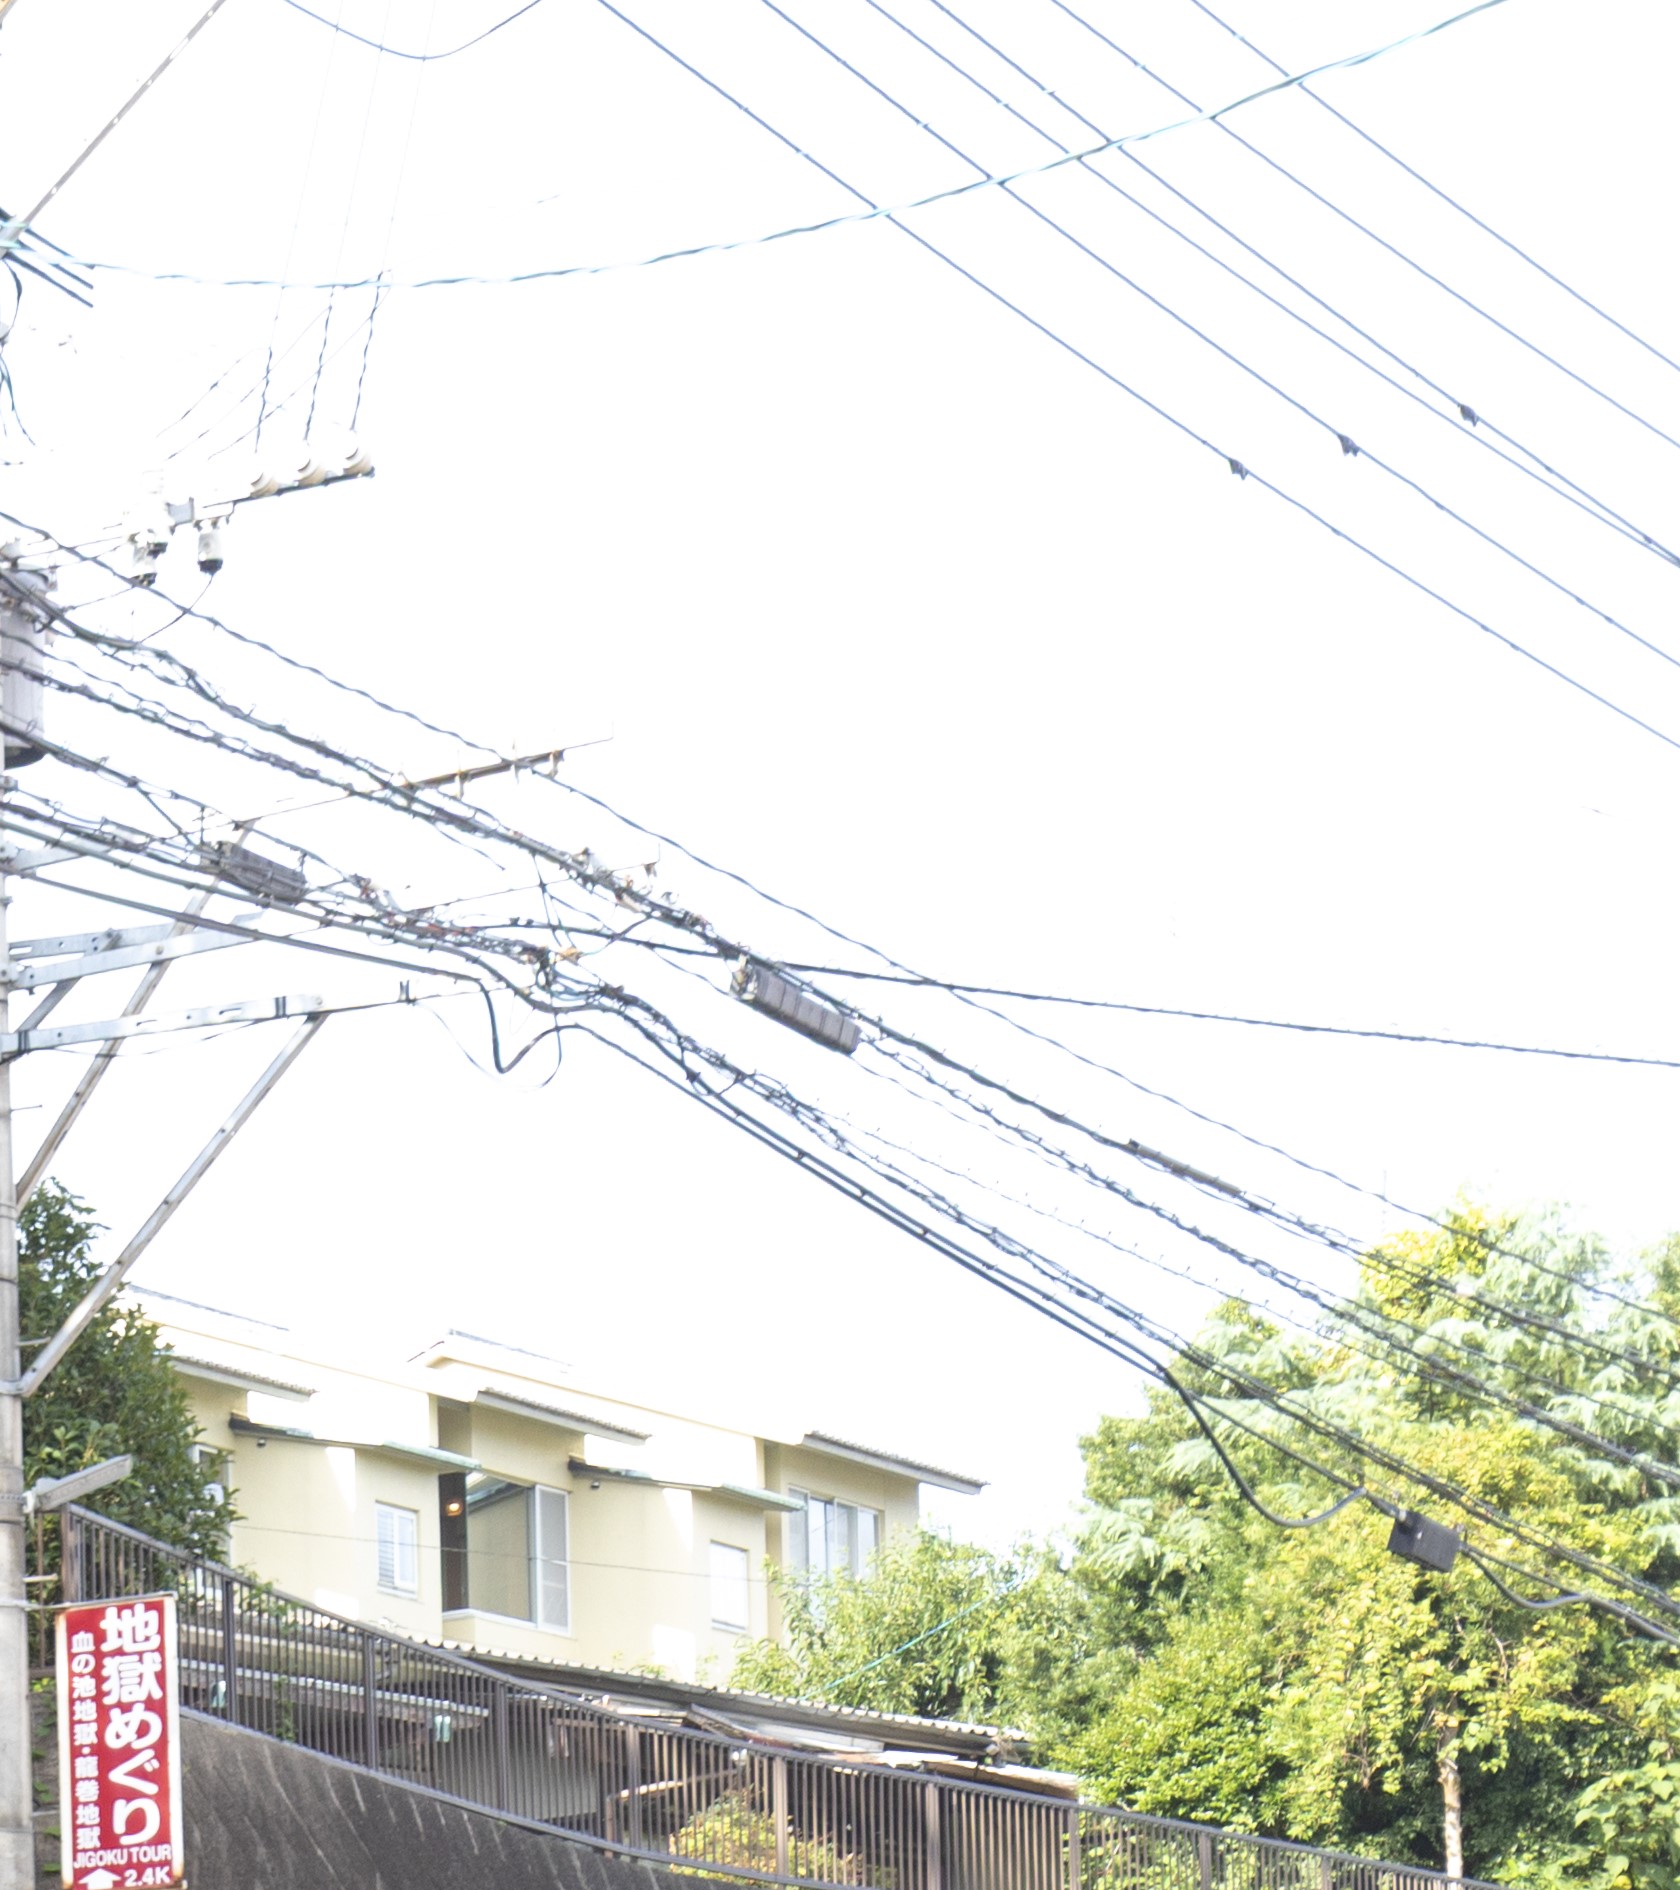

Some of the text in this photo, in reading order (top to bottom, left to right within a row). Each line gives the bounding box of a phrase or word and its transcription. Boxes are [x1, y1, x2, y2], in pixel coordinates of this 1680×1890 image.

[100, 1603, 164, 1846] 地獄めぐり
[73, 1844, 172, 1869] JIGOKU TOUR
[124, 1866, 171, 1888] 2.4K
